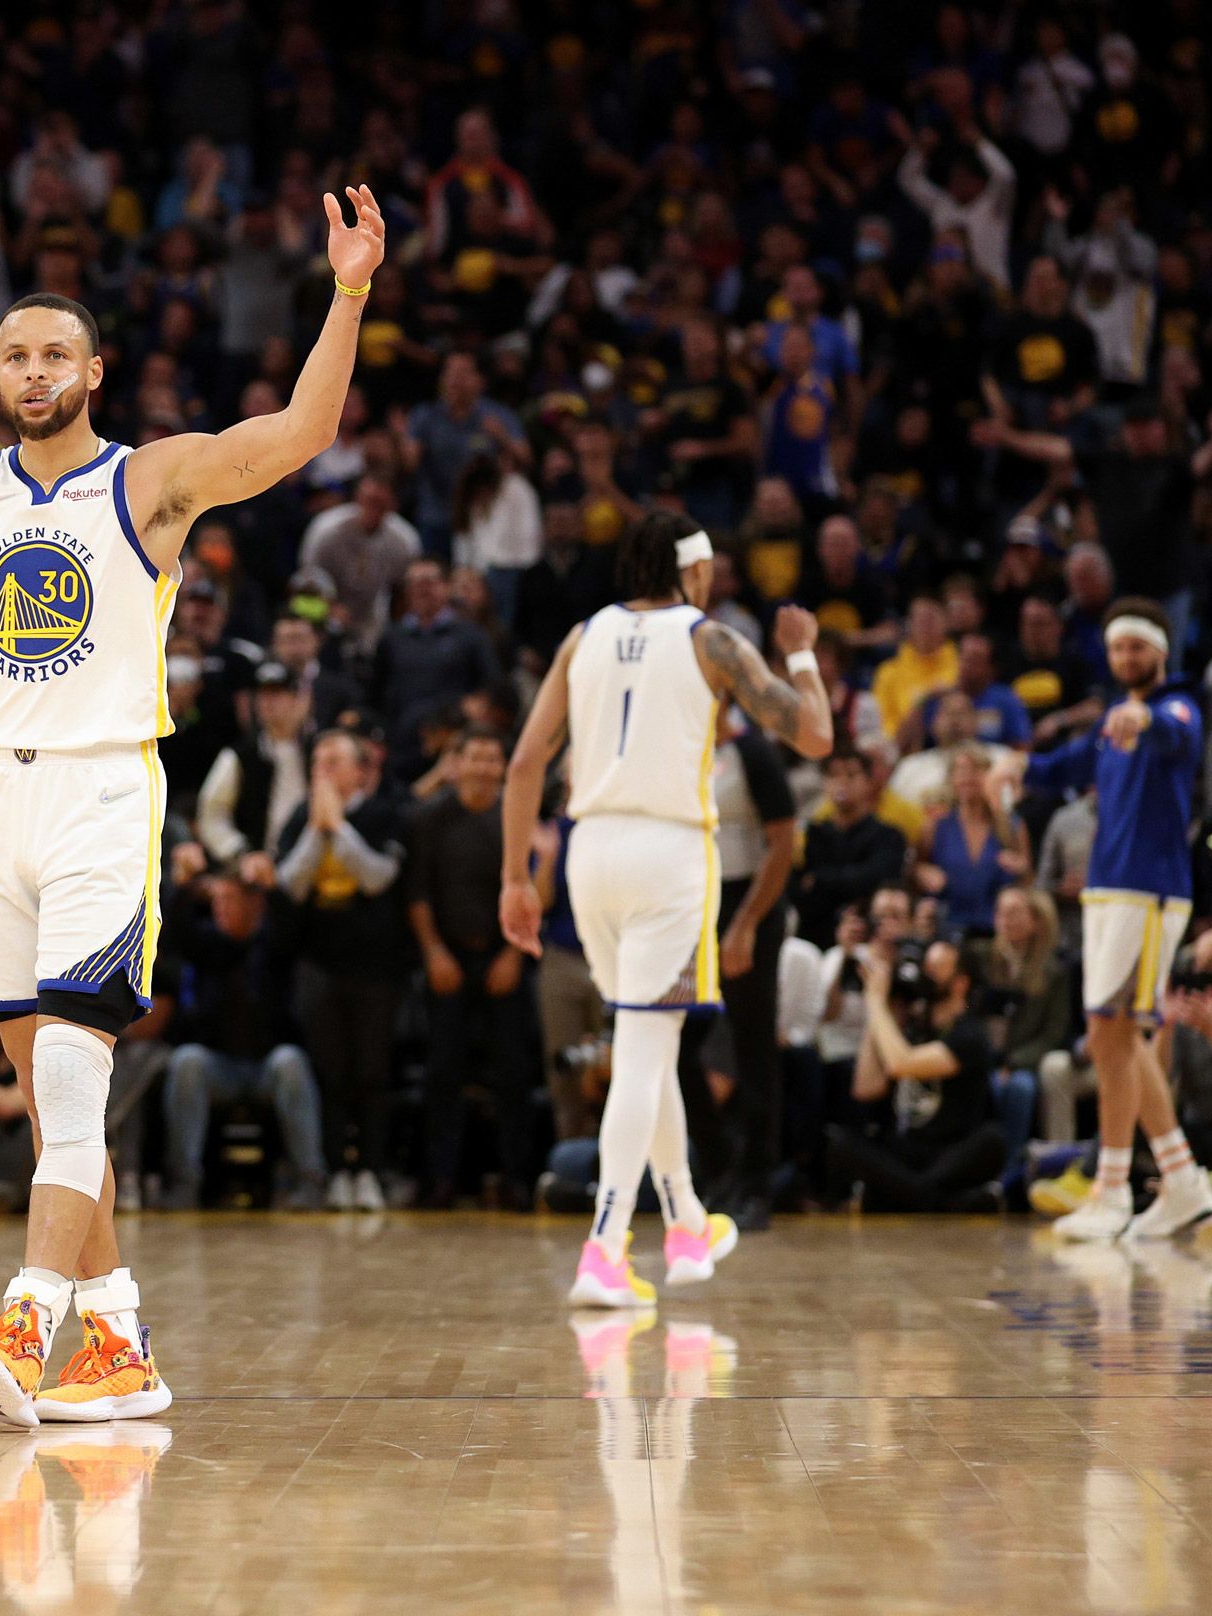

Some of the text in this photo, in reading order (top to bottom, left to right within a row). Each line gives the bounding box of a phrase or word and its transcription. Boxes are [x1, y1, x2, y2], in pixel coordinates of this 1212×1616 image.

[62, 488, 108, 500] Rakuten
[52, 530, 95, 565] STATE
[38, 570, 79, 603] 30
[616, 635, 647, 663] LEE
[618, 687, 633, 757] 1
